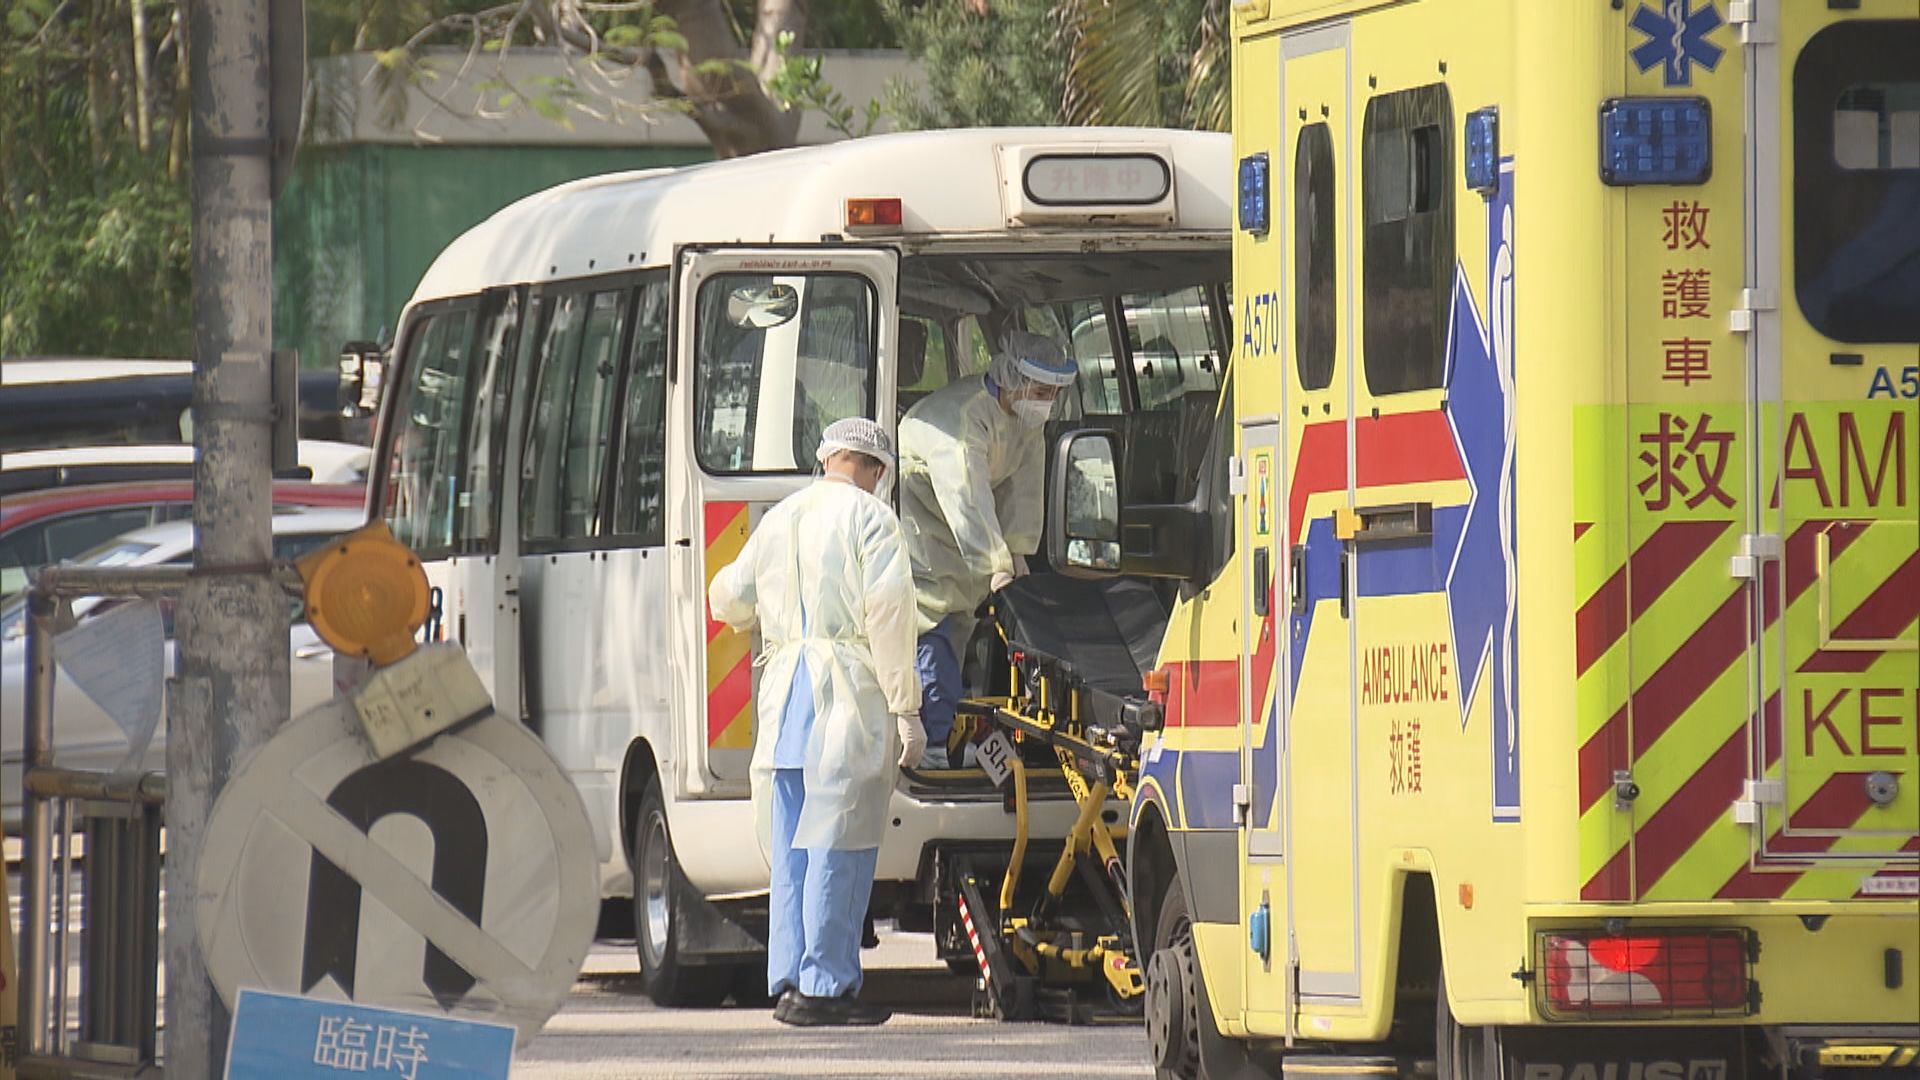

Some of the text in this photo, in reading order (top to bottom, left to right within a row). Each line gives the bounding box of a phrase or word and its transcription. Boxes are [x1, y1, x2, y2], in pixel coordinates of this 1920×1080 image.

[1243, 291, 1278, 358] A570
[1660, 200, 1711, 386] 救護車
[1867, 366, 1919, 398] A5
[1637, 412, 1736, 511] 救
[1769, 411, 1906, 509] AM
[1363, 642, 1448, 704] AMBULANCE
[1804, 688, 1919, 756] KE
[1390, 718, 1422, 795] 救護
[313, 1015, 429, 1080] 臨時
